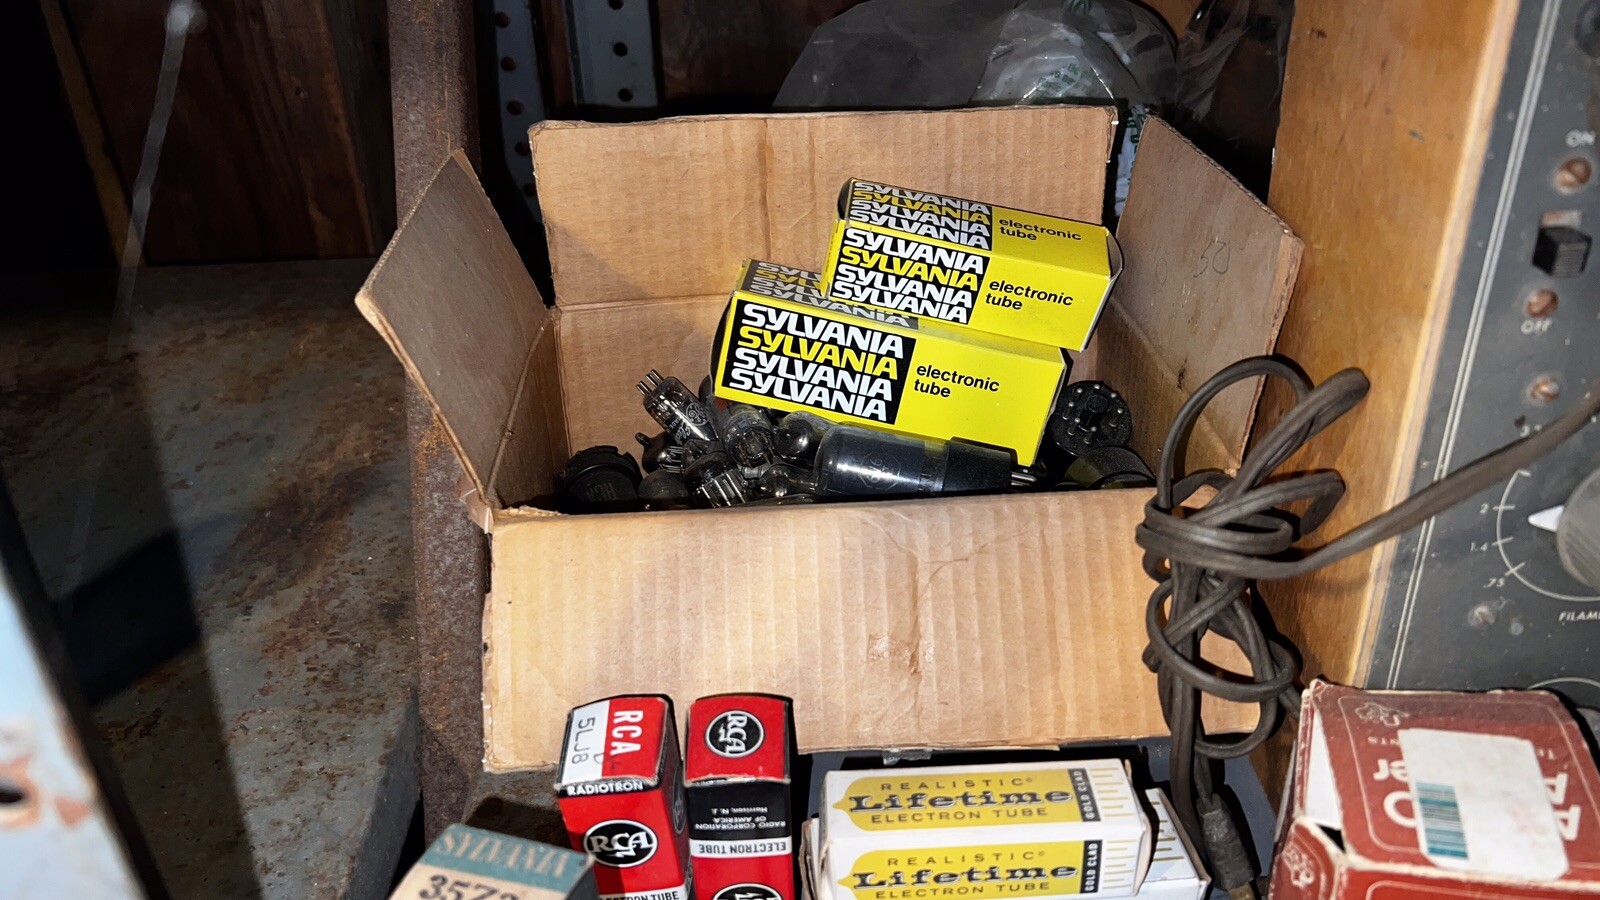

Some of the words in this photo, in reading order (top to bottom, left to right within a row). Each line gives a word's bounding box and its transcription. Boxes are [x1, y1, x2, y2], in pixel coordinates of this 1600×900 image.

[853, 190, 991, 226] SYLVANIA
[854, 182, 991, 215] SYLVANIA
[849, 209, 990, 250] SYLVANIA
[851, 199, 991, 237] SYLVANIA
[999, 218, 1082, 241] electronic
[1000, 226, 1037, 241] tube
[843, 229, 984, 275] SYLVANIA
[840, 246, 980, 291] SYLVANIA
[836, 264, 974, 308] SYLVANIA
[989, 281, 1075, 306] electronic
[832, 282, 968, 324] SYLVANIA
[986, 293, 1023, 310] tube
[741, 303, 904, 358] SYLVANIA
[737, 326, 898, 380] SYLVANIA
[733, 347, 892, 401] SYLVANIA
[917, 364, 1000, 392] electronic
[729, 368, 887, 422] SYLVANIA
[914, 379, 951, 398] tube
[1480, 503, 1490, 514] 2
[1558, 610, 1600, 621] FILAM
[571, 716, 596, 765] 5LJ8
[610, 709, 644, 756] RCA
[720, 713, 749, 755] RCA
[566, 780, 645, 796] RADIOTRON
[1073, 770, 1088, 792] CLAD
[848, 788, 1074, 814] Lifetime
[1081, 795, 1096, 820] GOLD
[694, 822, 756, 830] CORPORATION
[759, 820, 787, 828] RADIO
[871, 811, 982, 824] ELECTRON
[993, 807, 1048, 818] TUBE
[589, 831, 654, 858] RCA
[698, 843, 726, 854] TUBE
[729, 841, 787, 854] ELECTRON
[1087, 843, 1099, 866] CLAD
[852, 864, 1078, 890] Lifetime
[1084, 868, 1096, 891] GOLD
[875, 885, 985, 900] ELECTRON
[997, 882, 1050, 893] TUBE
